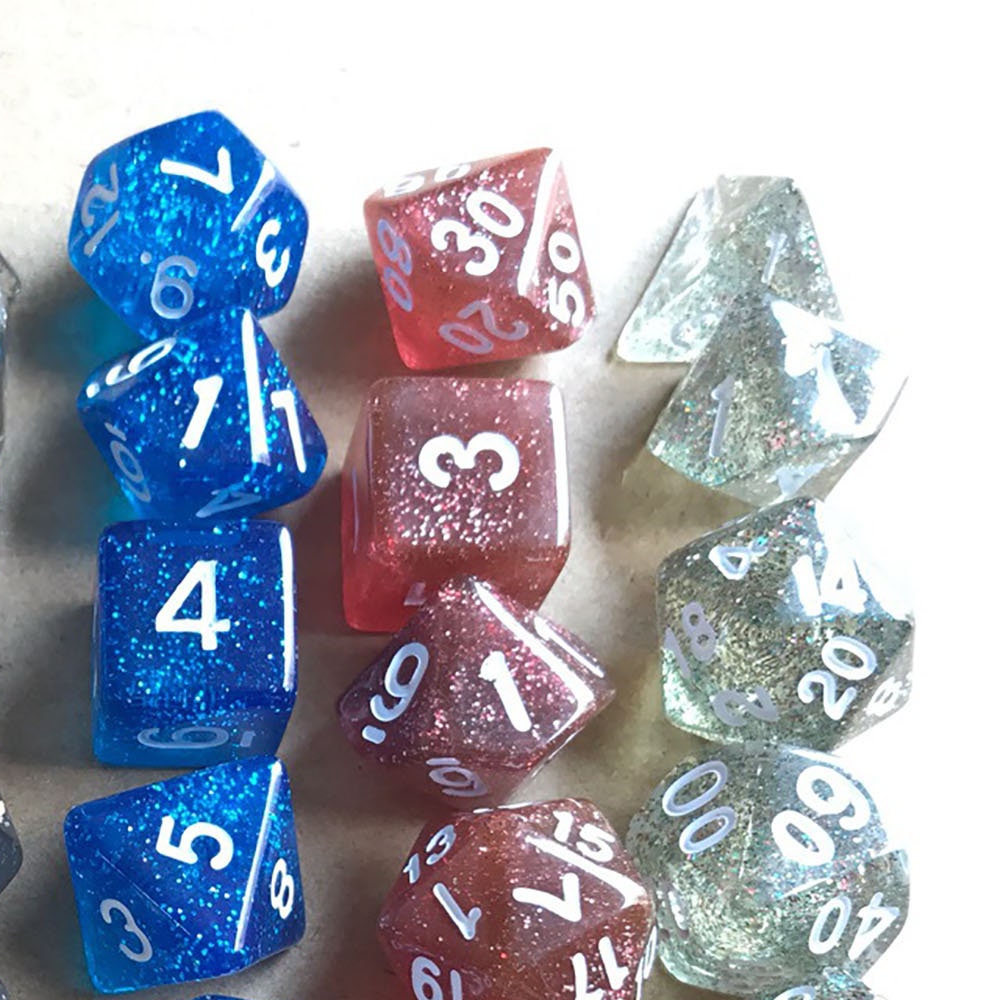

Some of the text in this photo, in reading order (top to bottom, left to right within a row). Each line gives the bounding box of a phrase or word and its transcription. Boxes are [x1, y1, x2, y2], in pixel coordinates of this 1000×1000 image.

[160, 146, 235, 195] 7
[256, 218, 290, 288] 3
[430, 189, 526, 276] 30
[438, 299, 530, 355] 20
[180, 375, 223, 449] 1
[270, 389, 307, 473] 7
[709, 375, 735, 457] 1
[418, 431, 520, 492] 3
[155, 560, 231, 651] 4
[370, 642, 429, 722] 9
[478, 650, 532, 733] 1
[797, 635, 877, 721] 20
[553, 811, 616, 863] 15
[662, 760, 736, 853] 00
[155, 815, 234, 870] 5
[402, 825, 456, 884] 13
[270, 858, 294, 919] 8
[433, 882, 482, 940] 1
[511, 873, 582, 922] 7
[100, 898, 153, 962] 3
[808, 893, 899, 961] 40
